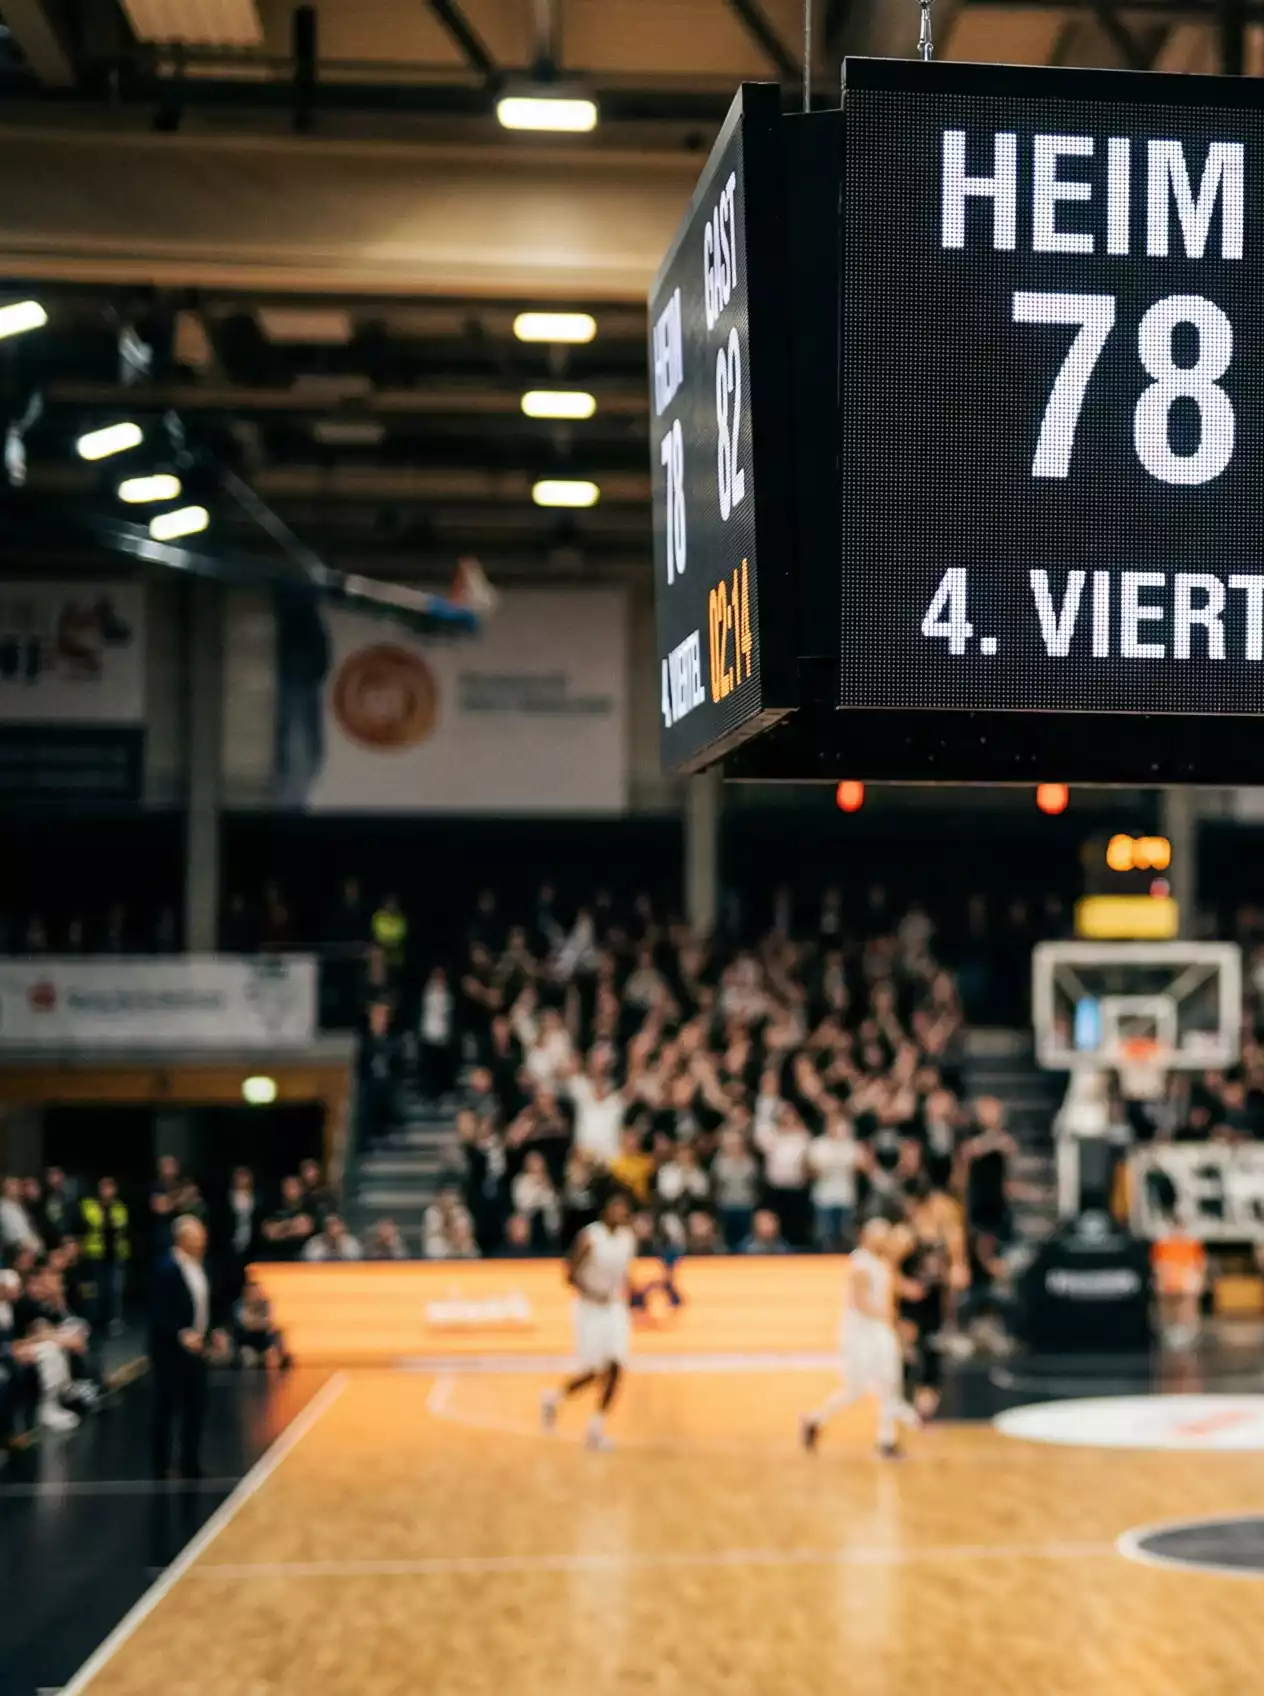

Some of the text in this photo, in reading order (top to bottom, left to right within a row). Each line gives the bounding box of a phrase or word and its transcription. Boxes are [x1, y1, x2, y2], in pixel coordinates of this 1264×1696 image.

[704, 171, 737, 330] GAST
[940, 129, 1246, 260] HEIM
[716, 327, 745, 522] 82
[1010, 290, 1238, 487] 78
[661, 418, 687, 585] 78
[709, 557, 752, 703] 02:14
[919, 566, 1001, 656] 4.
